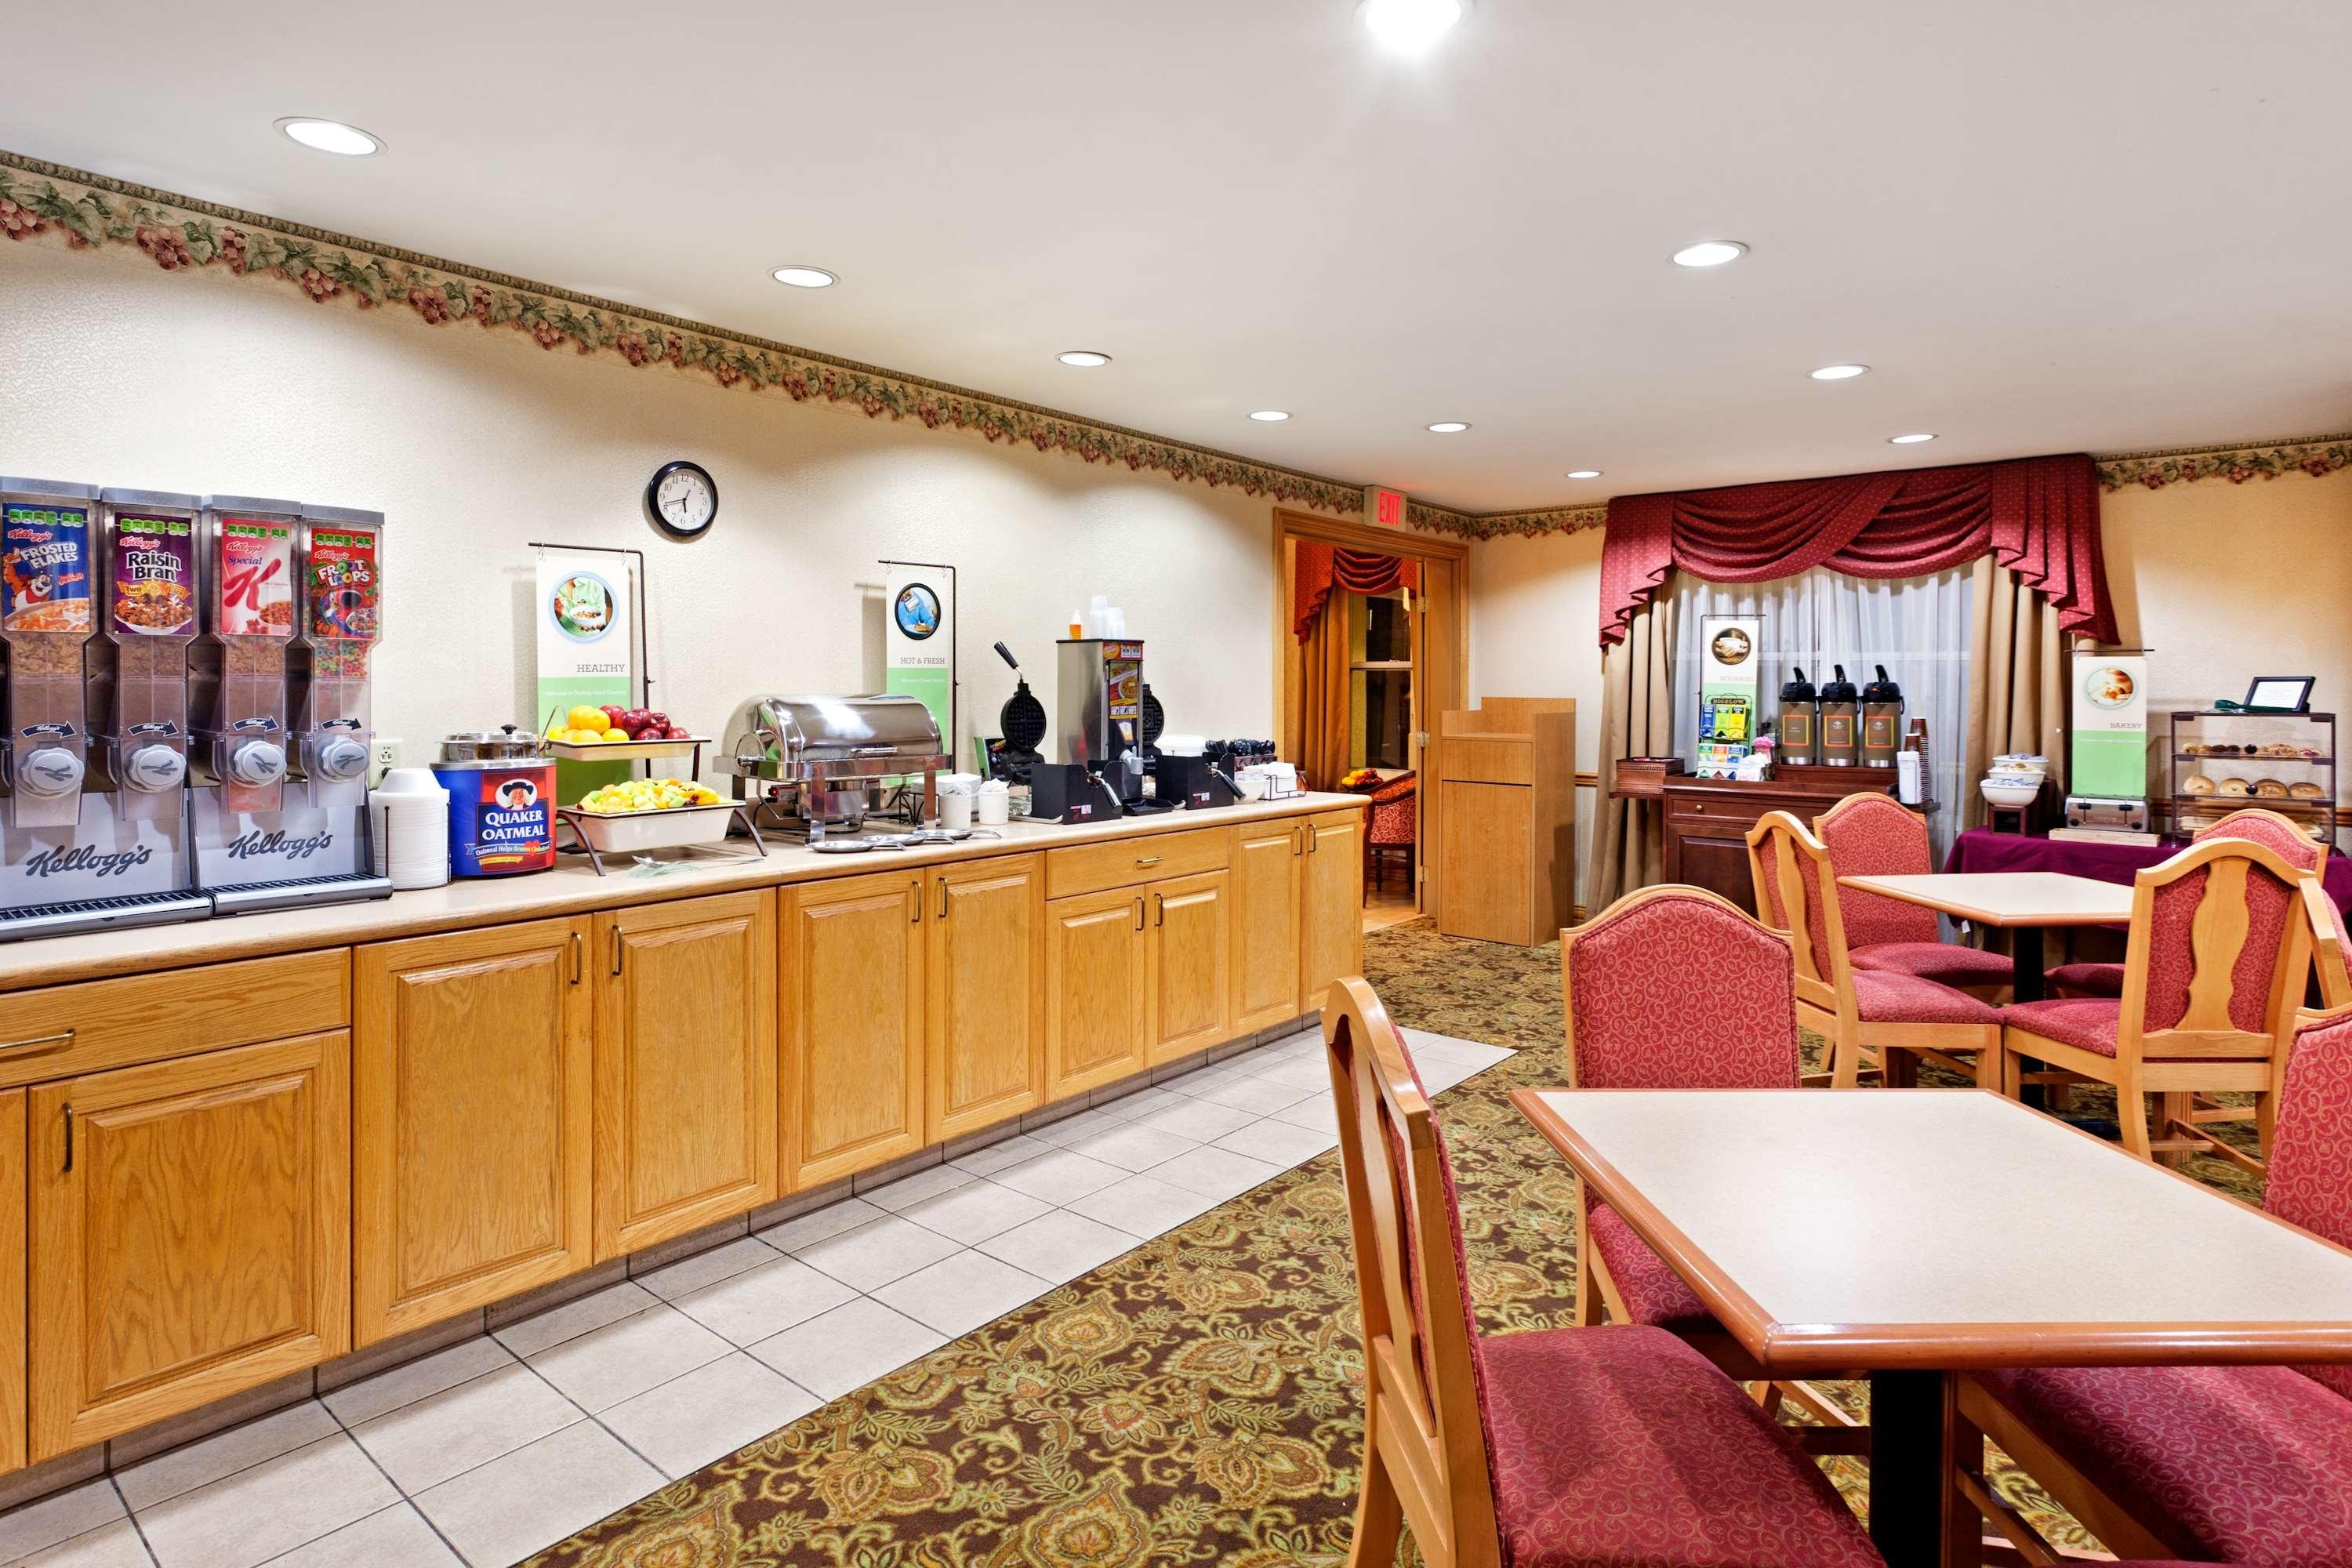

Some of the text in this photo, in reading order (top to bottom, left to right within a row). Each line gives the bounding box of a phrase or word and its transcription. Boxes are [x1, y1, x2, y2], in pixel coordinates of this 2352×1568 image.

[673, 475, 678, 484] 11
[681, 474, 689, 482] 12
[664, 482, 672, 492] 10
[702, 497, 708, 506] 3
[1379, 492, 1401, 526] EXIT
[681, 516, 686, 524] 6
[8, 528, 53, 543] Kellogg's
[119, 536, 161, 550] Kellogg's
[20, 543, 78, 561] FROSTED
[227, 541, 263, 554] Kellogg's
[314, 549, 350, 561] Kellogg's
[31, 552, 78, 569] FLAKES
[127, 551, 181, 570] Raisin
[227, 556, 263, 565] Special
[133, 565, 176, 582] Bran
[328, 571, 370, 586] LOOPS
[223, 557, 281, 611] K
[577, 664, 626, 673] HEALTHY
[485, 810, 544, 826] QUAKER
[482, 825, 545, 840] OATMEAL
[228, 829, 333, 859] Kellogg's
[475, 846, 498, 856] Oatmeal
[26, 844, 152, 877] Kellogg's
